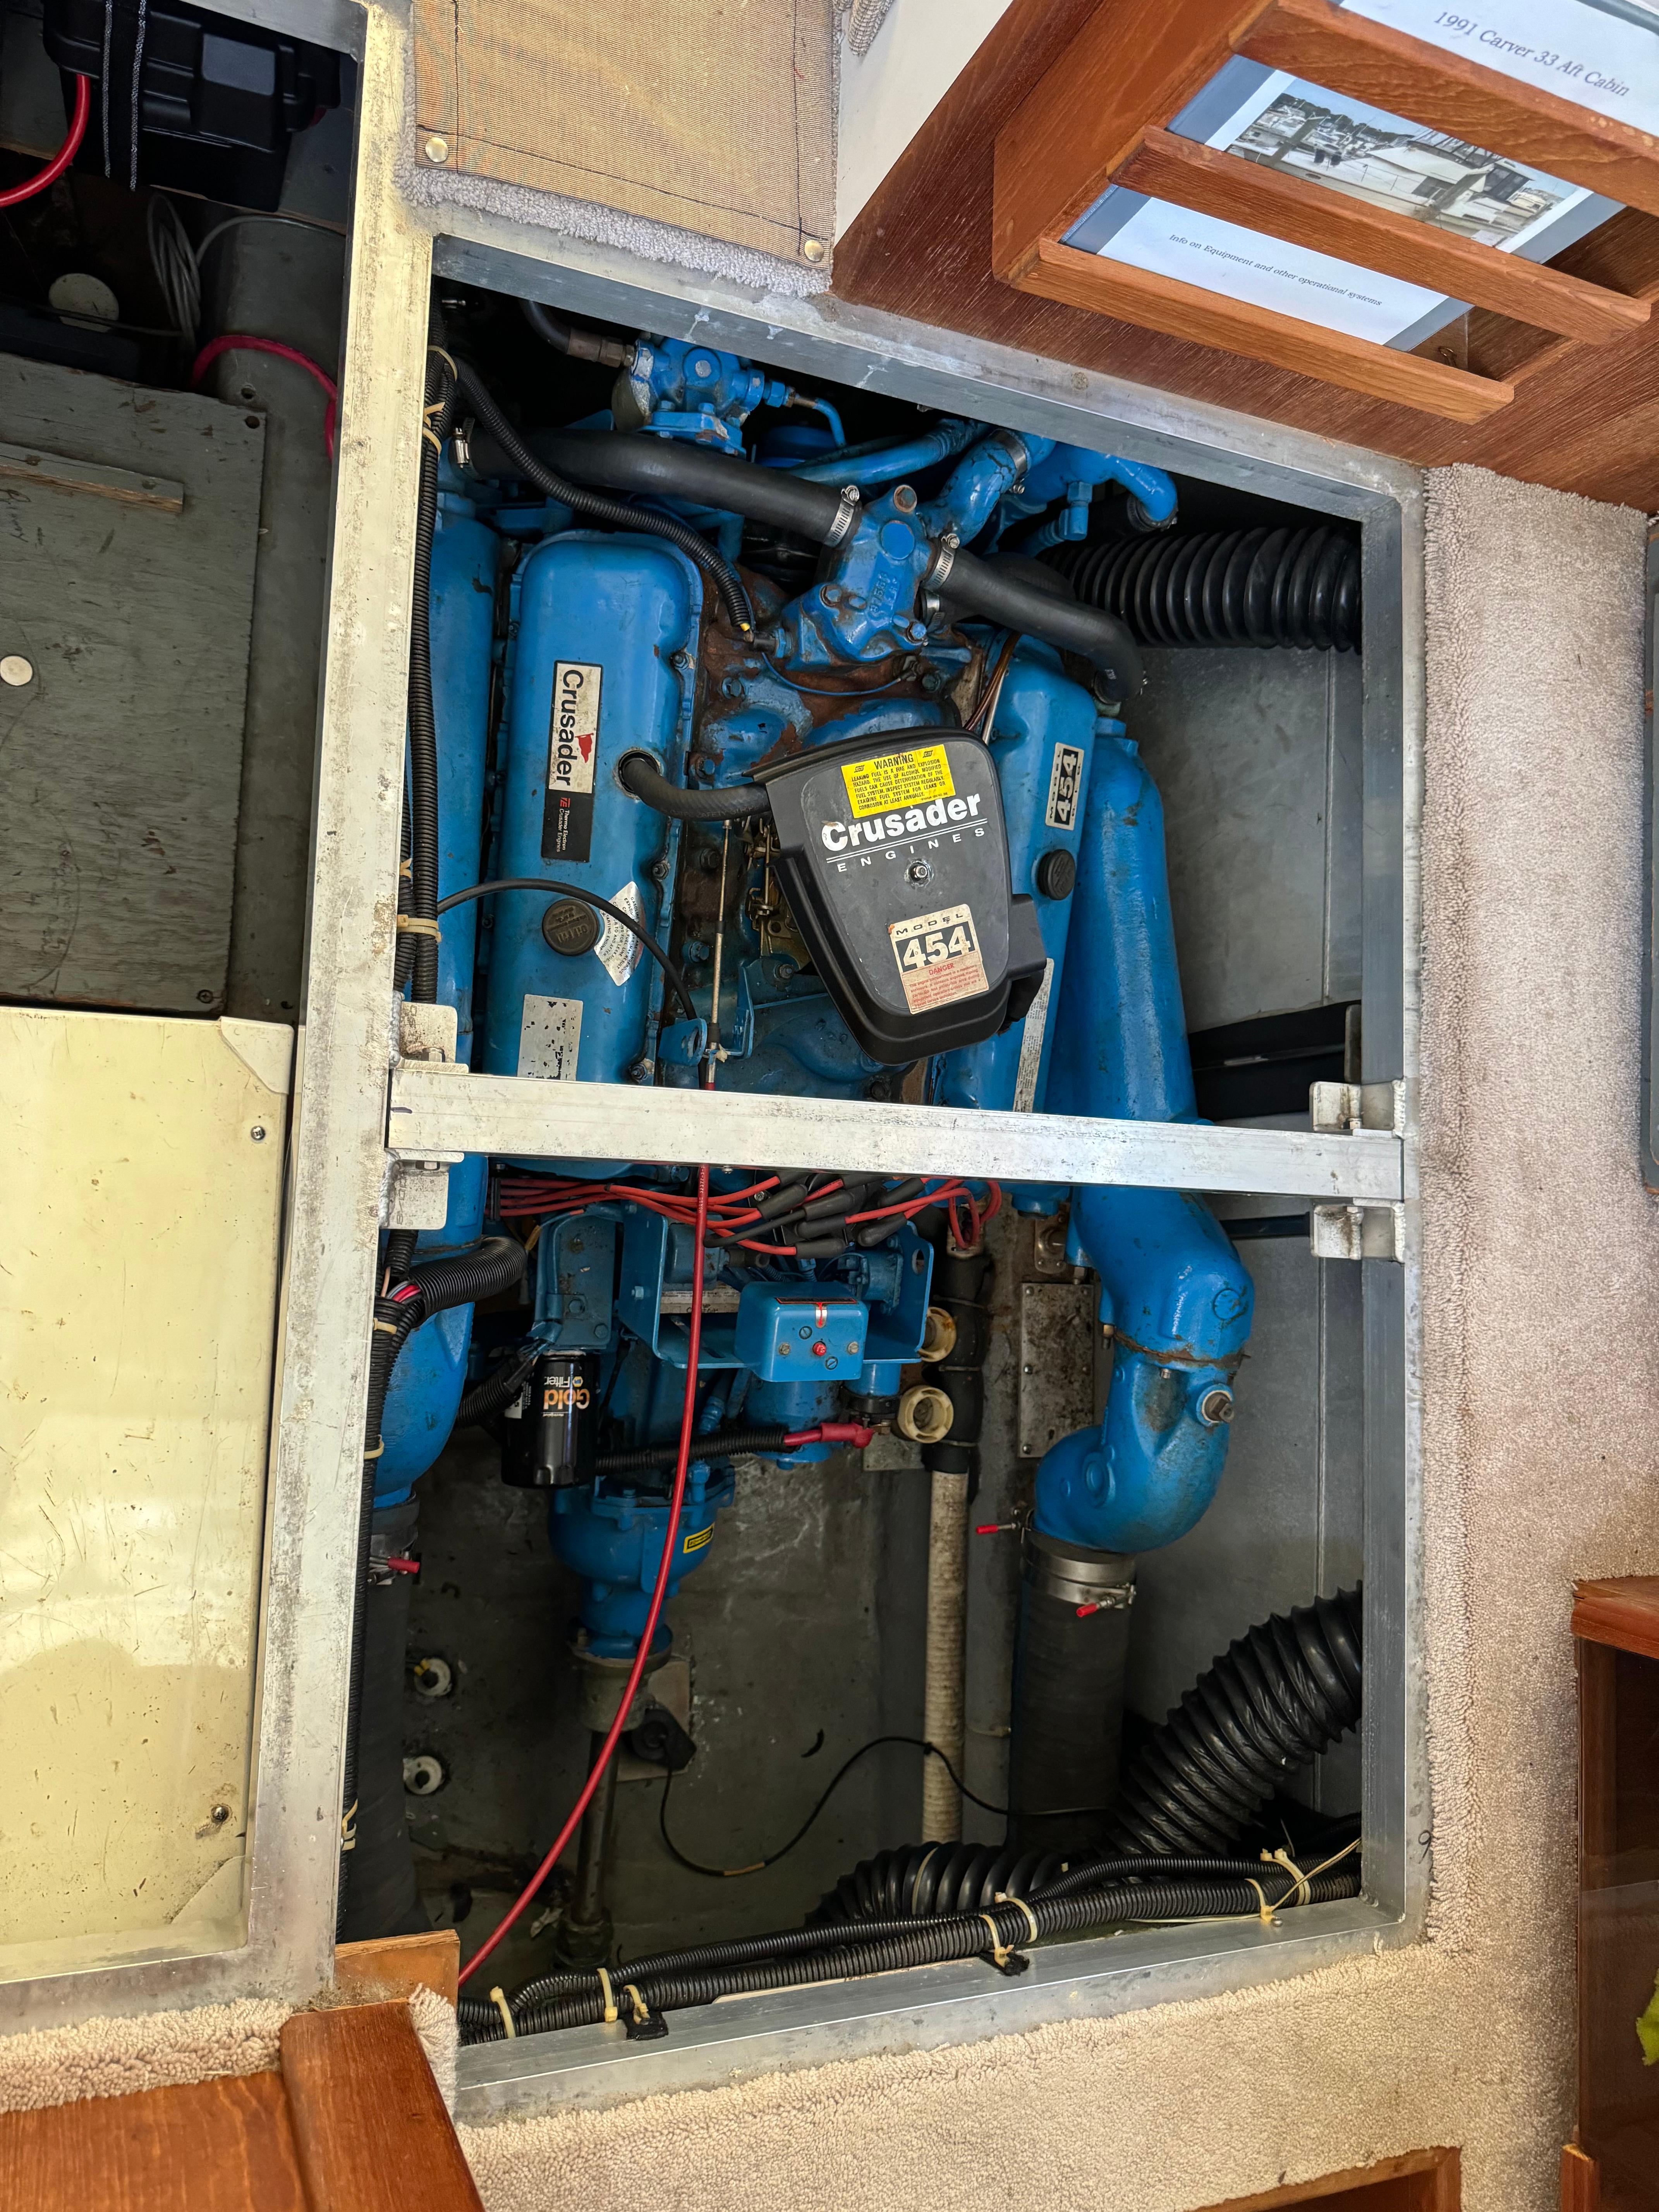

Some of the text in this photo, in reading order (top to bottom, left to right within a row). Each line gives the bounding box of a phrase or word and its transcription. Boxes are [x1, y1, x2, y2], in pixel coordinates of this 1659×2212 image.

[1433, 8, 1632, 98] 1991 Carver 33 Aft Cabin
[1169, 233, 1382, 307] Info on Equipment and other operational systems
[556, 669, 584, 786] Crusader
[851, 774, 869, 782] LEAKING
[917, 758, 939, 767] EXPLOSION
[874, 753, 914, 770] WARNING
[901, 768, 919, 776] ALCOHOL
[921, 763, 941, 772] MODIFIED
[885, 784, 903, 792] INSPECT
[894, 773, 926, 784] DETERIORATION
[1057, 753, 1078, 822] 454
[857, 796, 877, 804] EXAMINE
[892, 788, 910, 797] SYSTEM
[859, 801, 882, 810] CORROSION
[903, 791, 924, 800] ANNUALLY.
[821, 793, 981, 852] Crusader
[837, 828, 985, 873] ENGINES
[896, 914, 963, 936] MODEL
[599, 935, 610, 951] ENGINE
[603, 943, 613, 957] AFTER
[903, 925, 971, 969] 454
[606, 944, 621, 962] LEAKAGE
[617, 954, 628, 969] RESULT
[619, 950, 635, 974] DANGEROUS
[928, 962, 955, 975] DANGER
[544, 1376, 570, 1387] Filter
[543, 1389, 589, 1409] Gold
